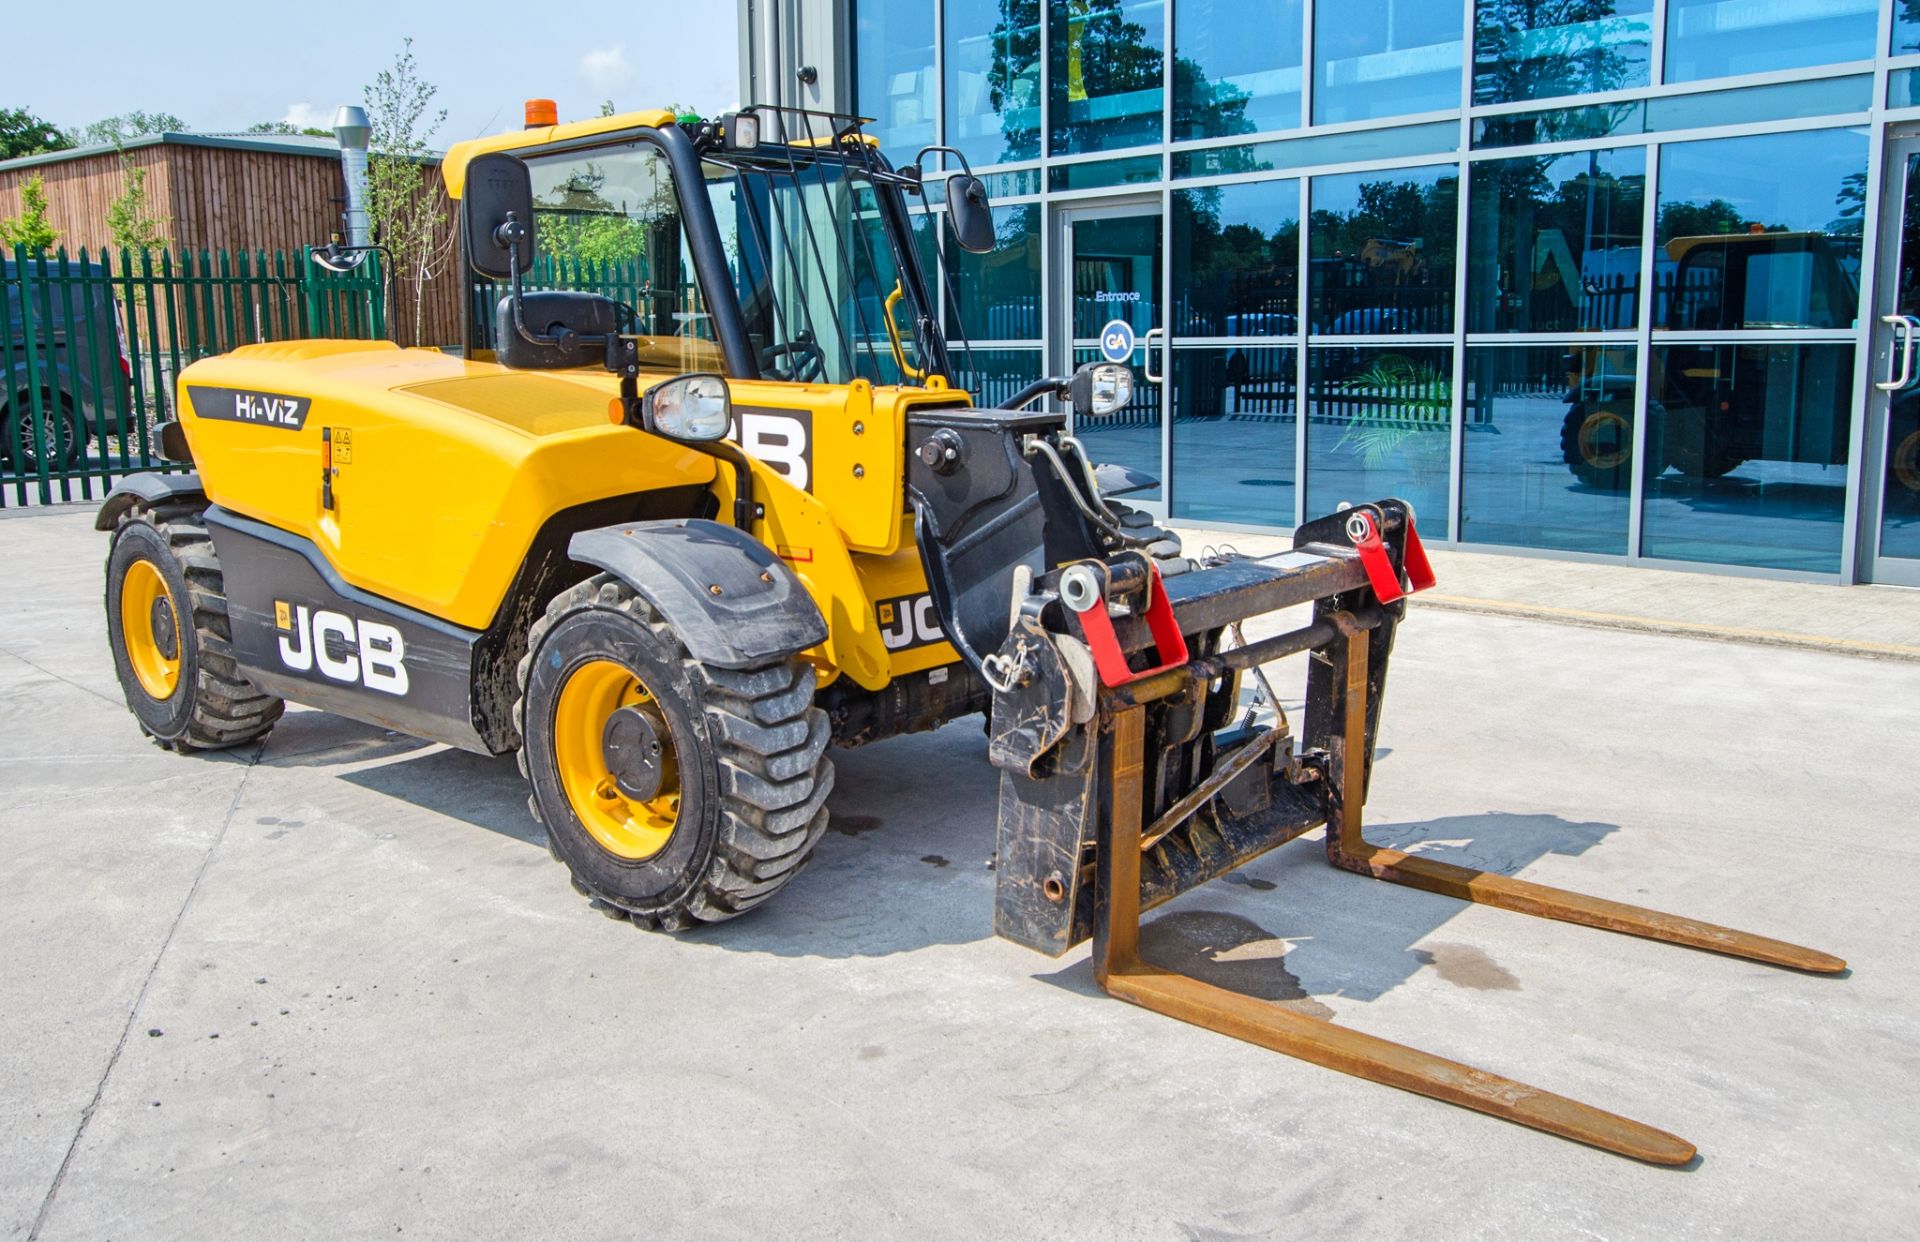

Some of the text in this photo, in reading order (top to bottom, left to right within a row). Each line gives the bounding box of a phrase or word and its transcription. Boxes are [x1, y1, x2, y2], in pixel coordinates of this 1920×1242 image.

[1096, 290, 1140, 302] Entrance
[727, 413, 808, 491] B
[278, 605, 409, 696] JCB
